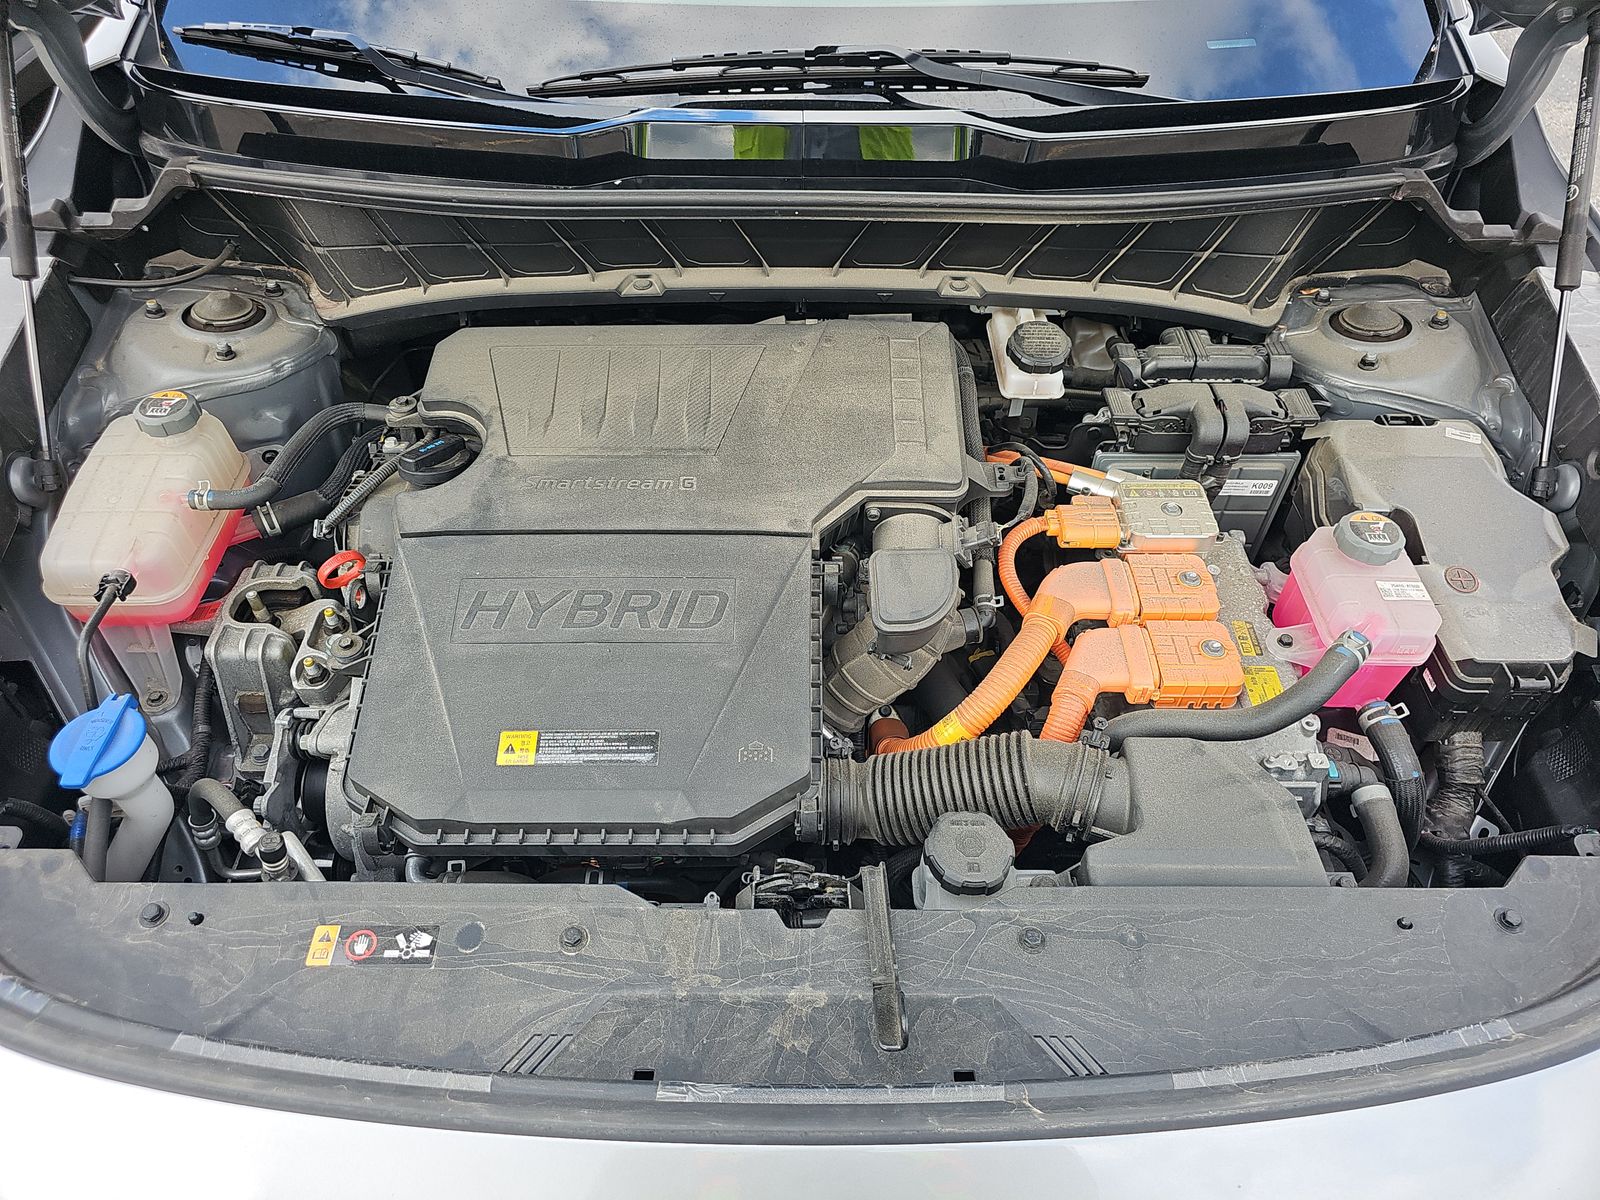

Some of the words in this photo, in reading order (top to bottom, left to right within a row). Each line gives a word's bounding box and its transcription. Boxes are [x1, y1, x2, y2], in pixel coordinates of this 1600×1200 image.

[521, 475, 674, 490] Smartstream
[680, 476, 697, 491] G
[460, 589, 730, 630] HYBRID
